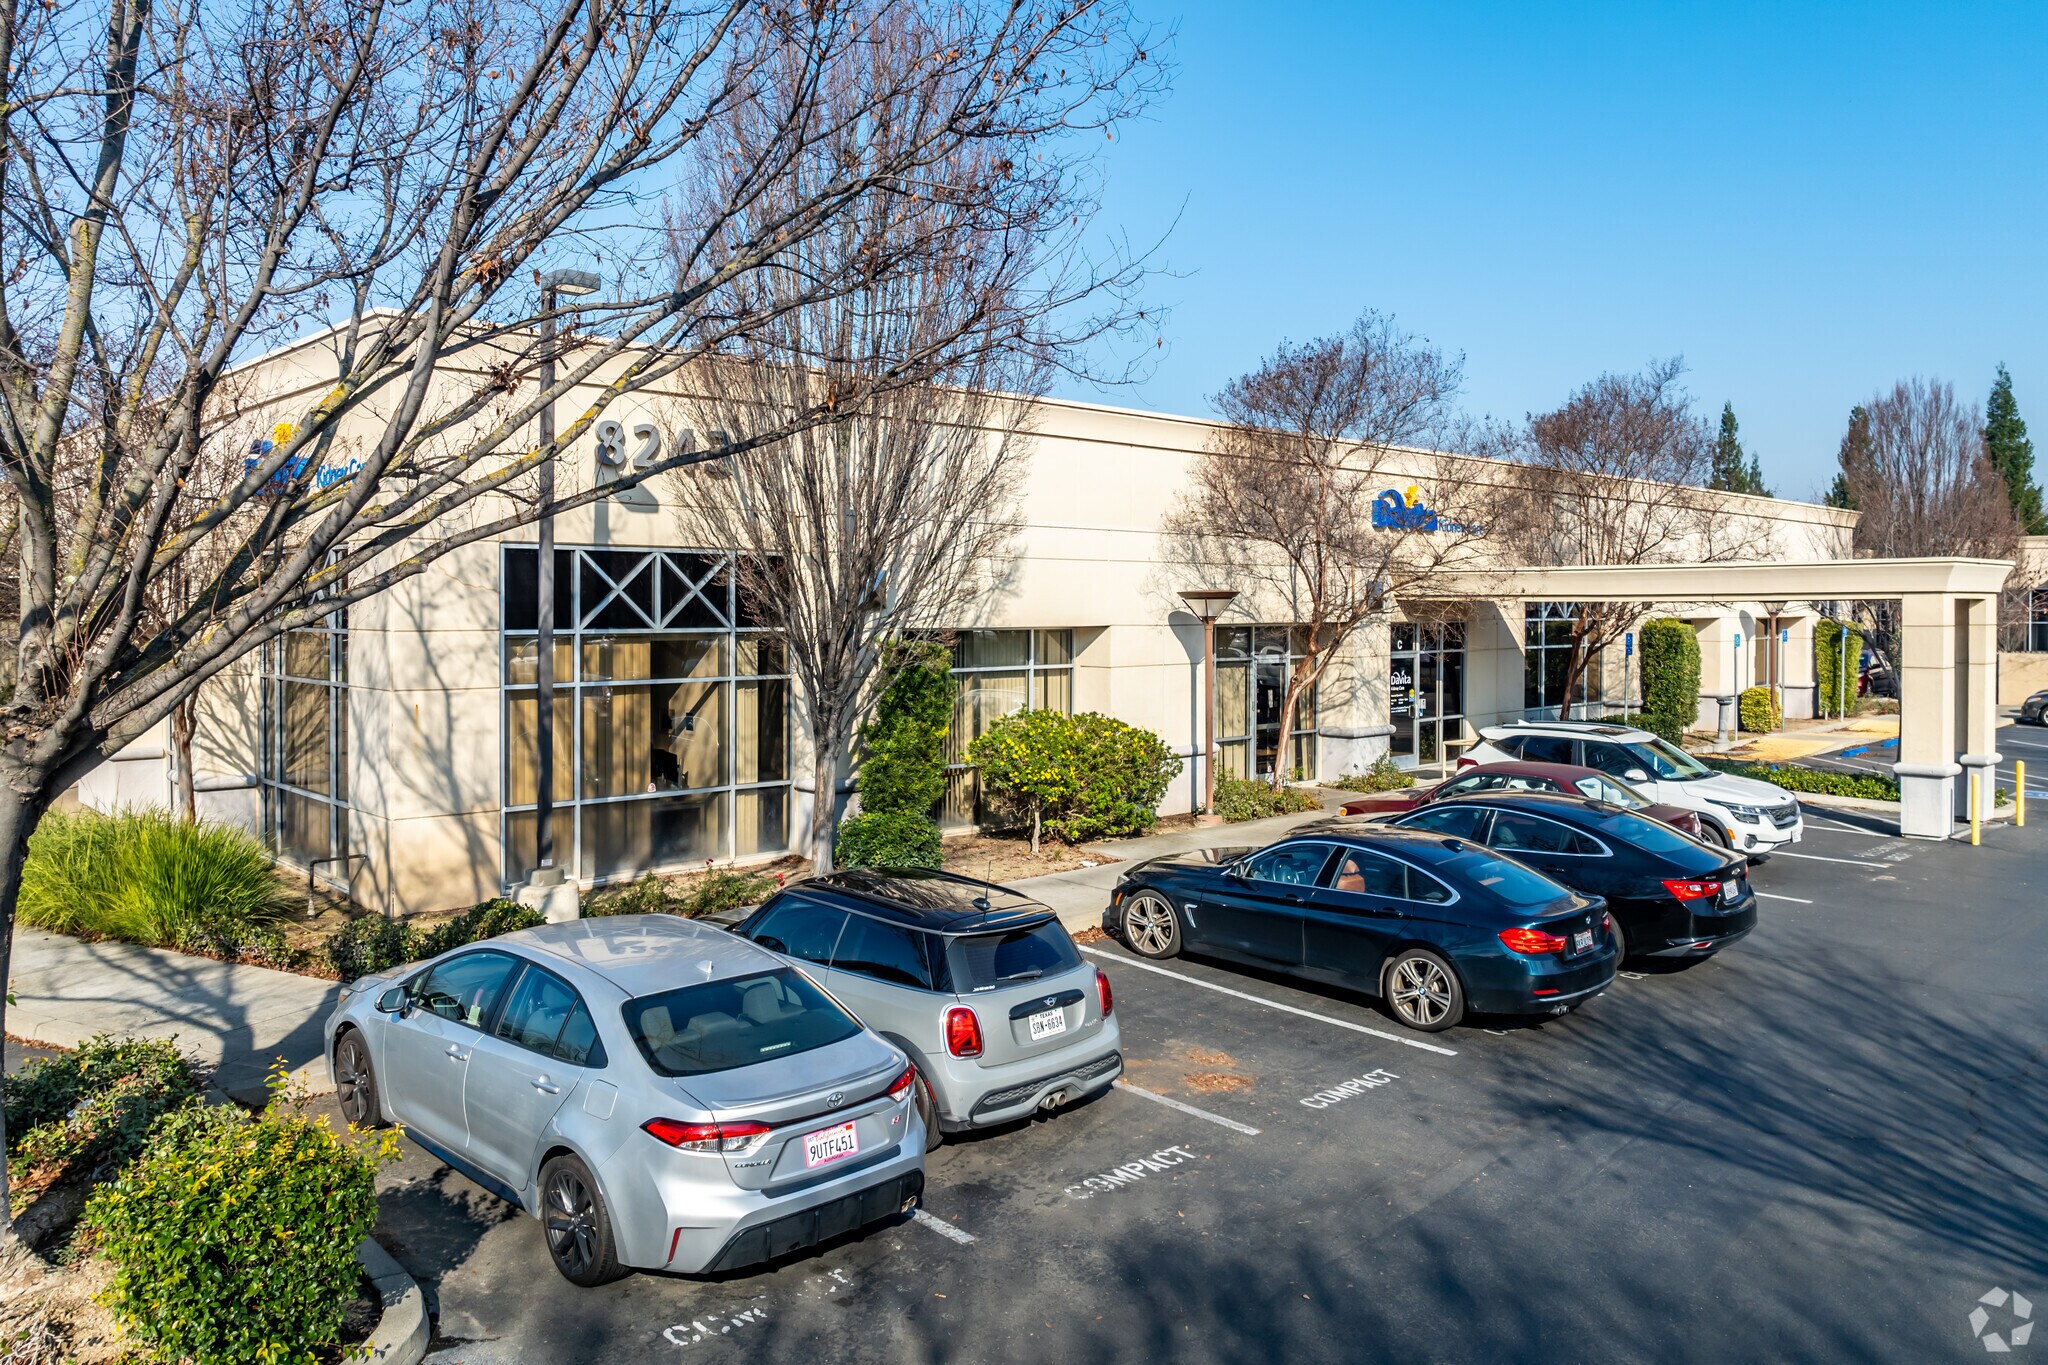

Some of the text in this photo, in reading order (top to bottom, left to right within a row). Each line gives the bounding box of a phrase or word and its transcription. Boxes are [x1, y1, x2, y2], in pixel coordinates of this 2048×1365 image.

[1397, 640, 1403, 649] C
[1299, 1068, 1400, 1110] COMPACT
[809, 1134, 855, 1162] 9UTF451
[1063, 1144, 1197, 1201] COMPACT
